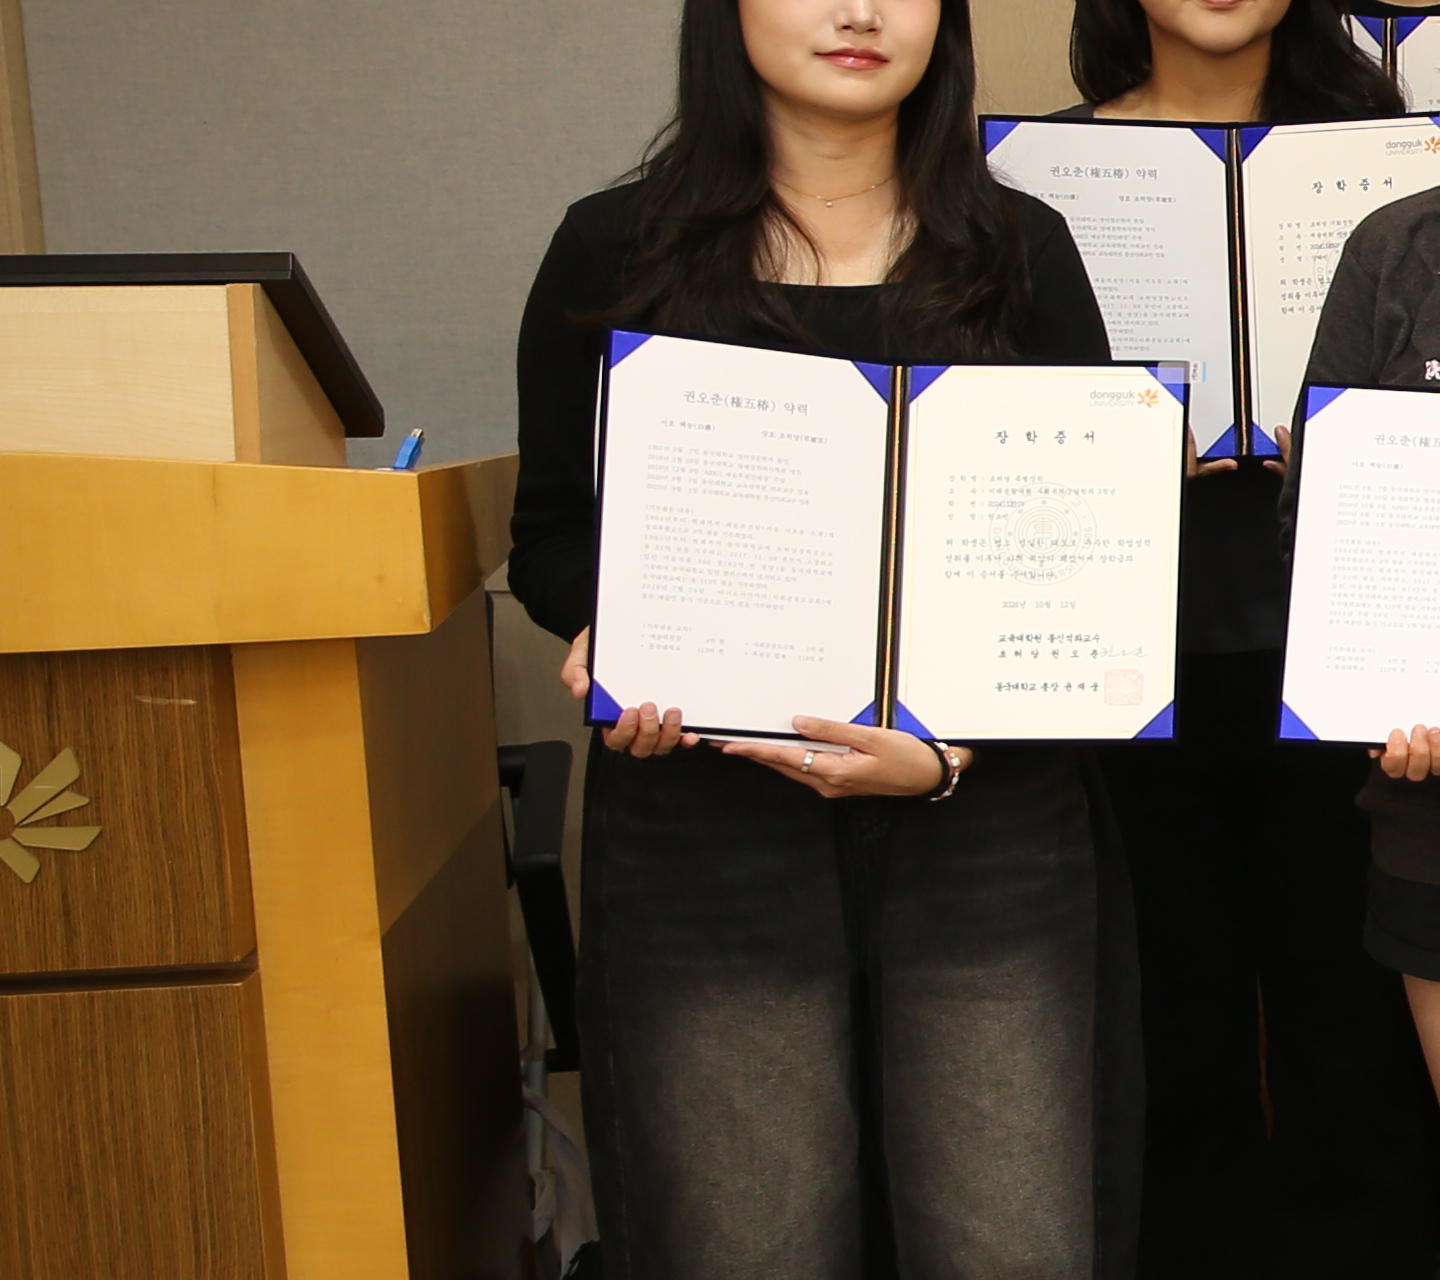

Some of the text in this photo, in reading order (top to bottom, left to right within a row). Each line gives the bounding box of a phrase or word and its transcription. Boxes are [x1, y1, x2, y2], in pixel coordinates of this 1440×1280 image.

[1386, 139, 1422, 150] dongguk
[1312, 177, 1392, 194] 장 학 증 서
[1089, 389, 1135, 402] dongguk
[995, 430, 1094, 444] 장 학 증 서
